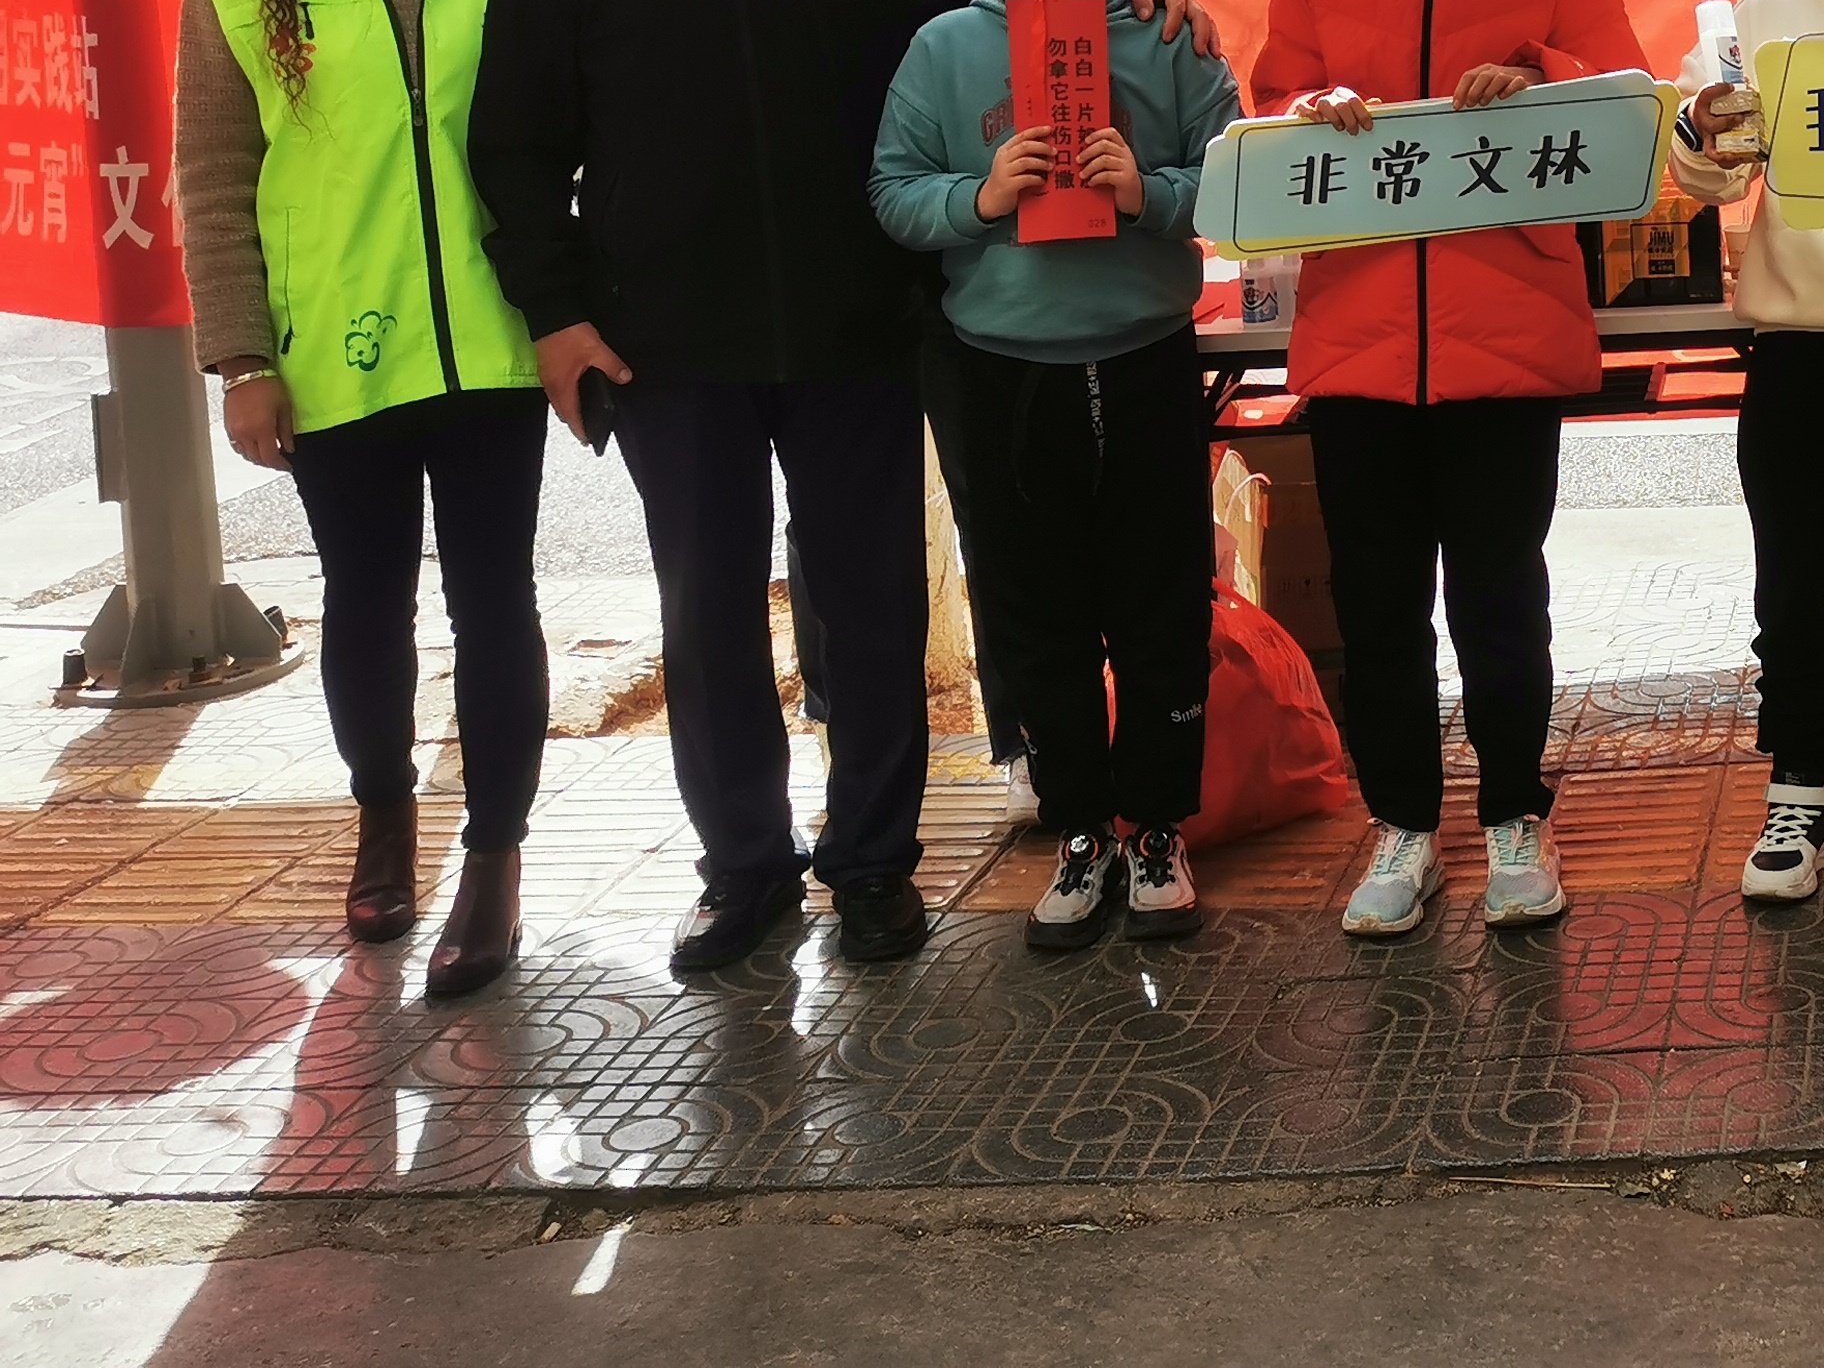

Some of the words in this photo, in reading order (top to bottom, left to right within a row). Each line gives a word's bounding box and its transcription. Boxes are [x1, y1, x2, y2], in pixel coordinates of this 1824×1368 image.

[0, 9, 99, 120] 实践站
[1048, 37, 1075, 190] 勿拿它往伤口撒
[1287, 129, 1593, 206] 非常文林
